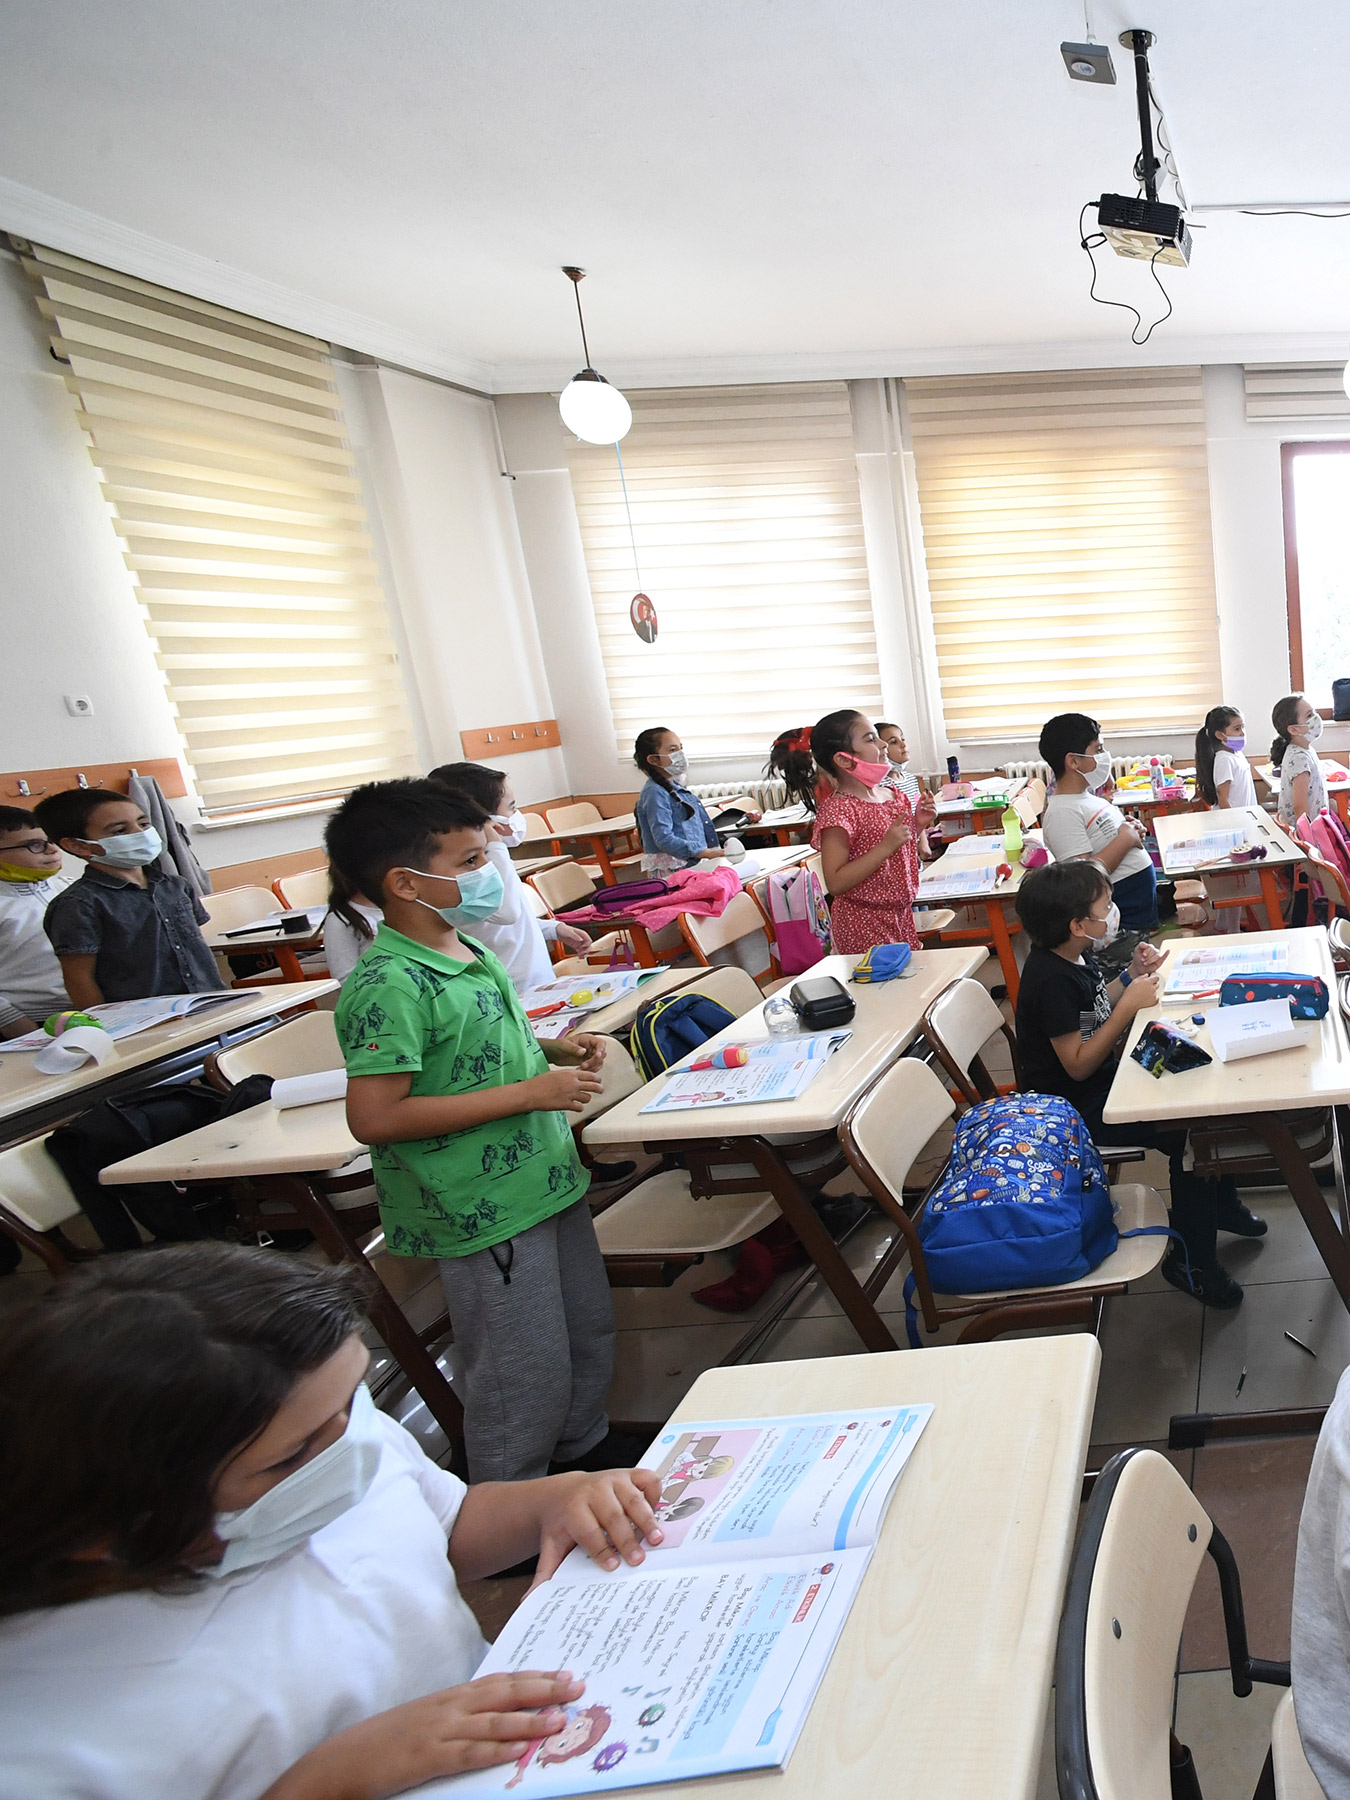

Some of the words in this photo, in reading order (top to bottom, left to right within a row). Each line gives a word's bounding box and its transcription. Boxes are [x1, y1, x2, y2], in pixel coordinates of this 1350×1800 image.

[715, 1573, 729, 1588] BAY
[698, 1590, 720, 1622] MİKROP
[657, 1620, 675, 1635] Bay
[763, 1630, 780, 1645] Bay
[511, 1648, 533, 1673] Mikro
[751, 1647, 772, 1673] Mikrop
